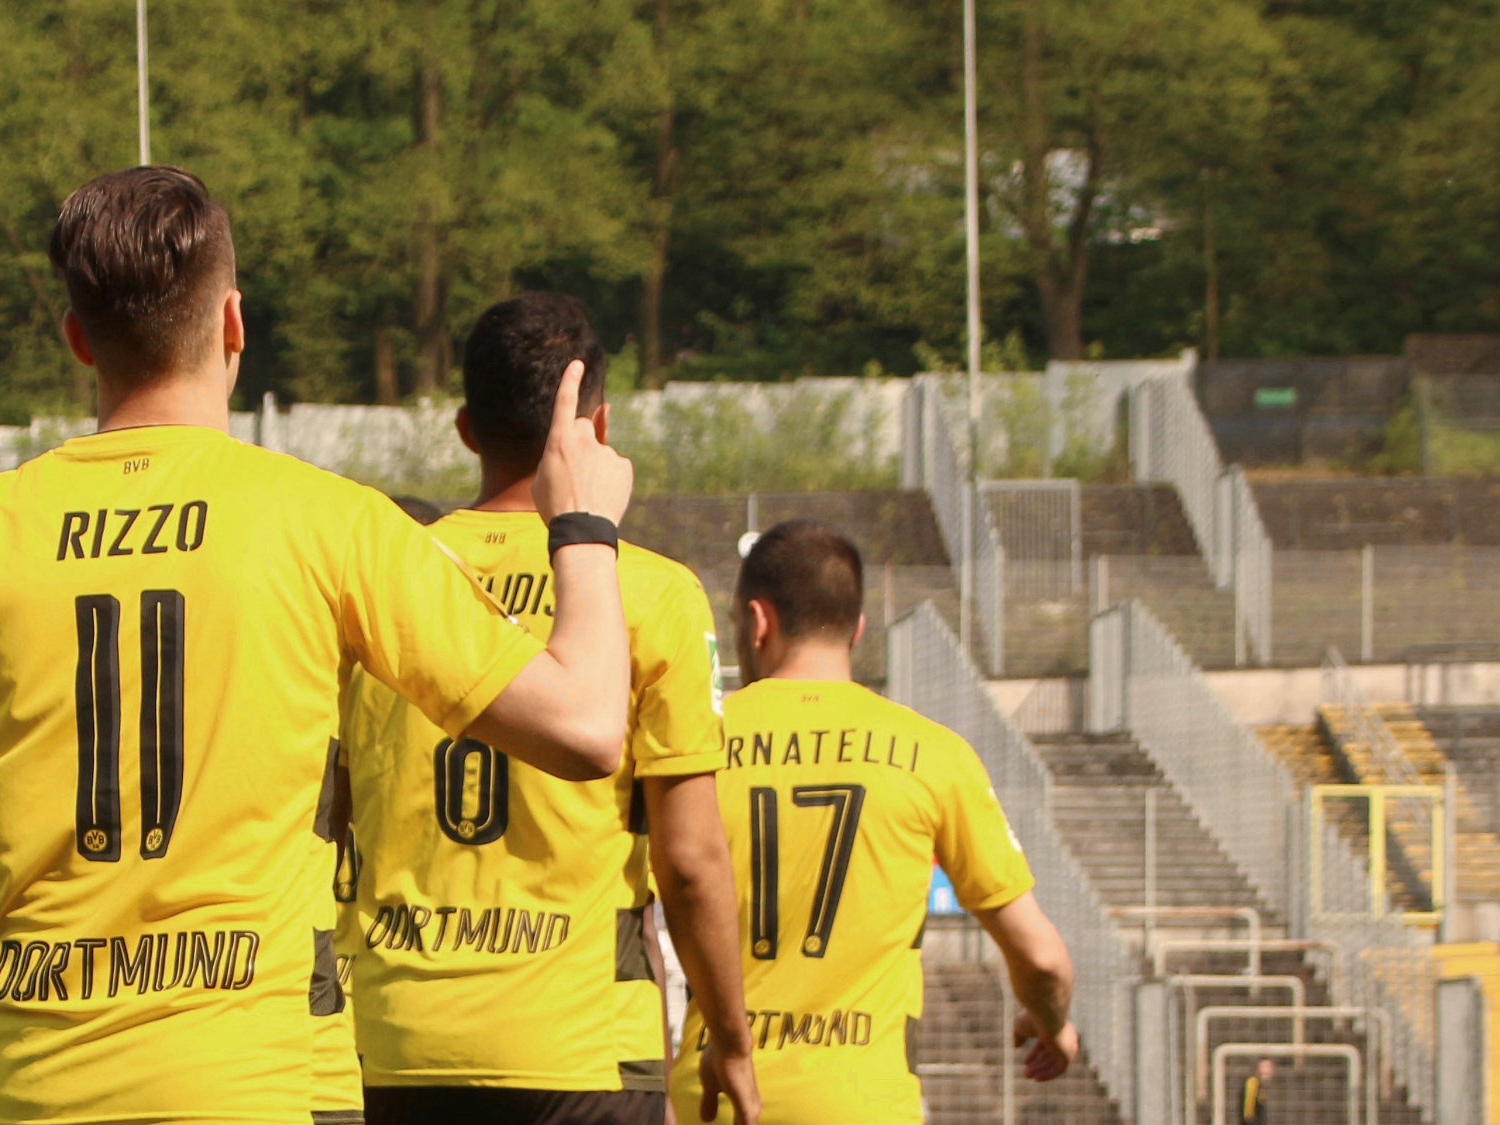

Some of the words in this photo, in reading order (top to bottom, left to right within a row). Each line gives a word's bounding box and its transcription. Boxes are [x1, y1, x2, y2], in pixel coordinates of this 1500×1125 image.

[123, 458, 150, 475] BVB
[56, 500, 208, 561] RIZZO
[75, 589, 186, 862] 11
[727, 729, 919, 772] RNATELLI
[750, 783, 866, 960] 17
[365, 903, 571, 955] DORTMUND
